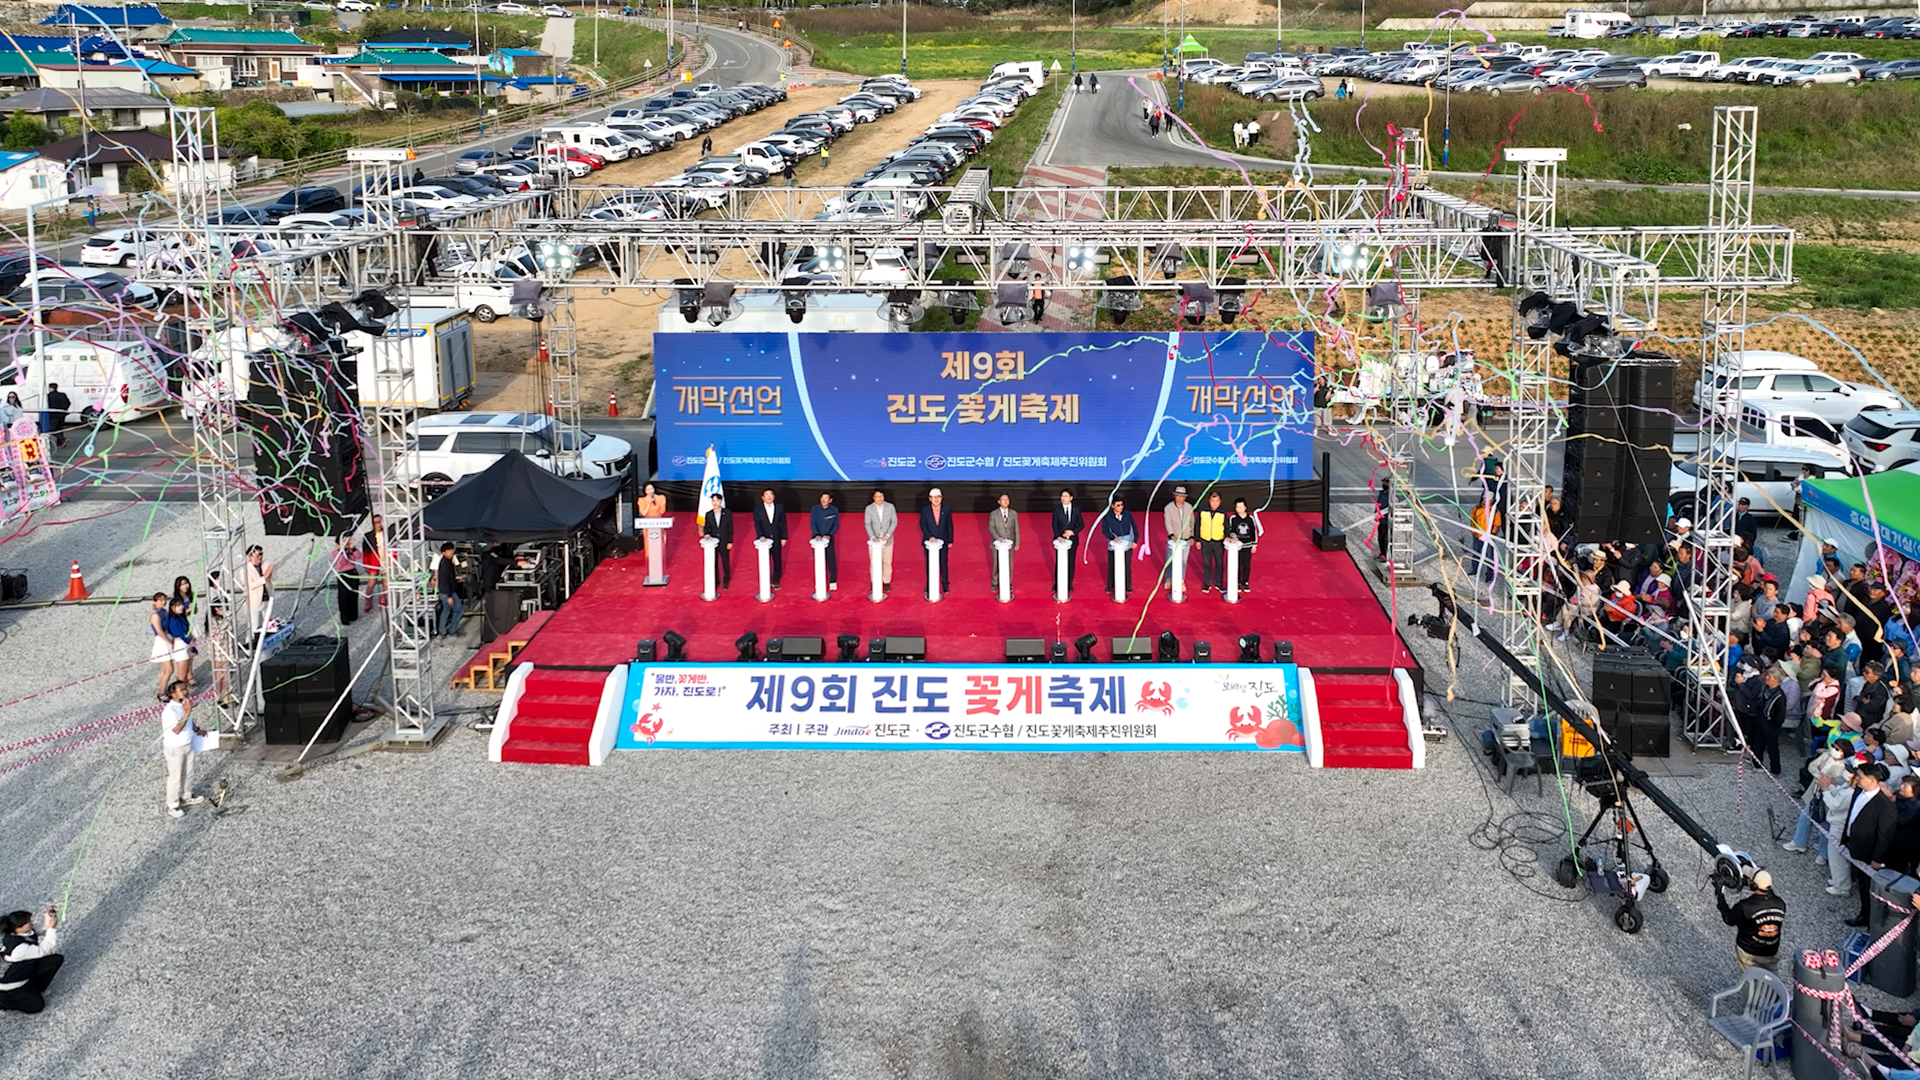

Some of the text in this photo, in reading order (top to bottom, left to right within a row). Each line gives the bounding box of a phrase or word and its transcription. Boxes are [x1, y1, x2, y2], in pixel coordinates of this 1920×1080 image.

[940, 350, 1026, 381] 제9회
[672, 385, 783, 415] 개막선언
[886, 392, 1081, 424] 진도 꽃게축제
[1186, 385, 1295, 415] 개막선언
[887, 456, 917, 468] 진도군
[947, 456, 994, 468] 진도군수협
[1002, 455, 1107, 468] 진도꽃게축제추진위원회
[653, 686, 679, 697] 가자,
[745, 674, 1127, 716] 제9회 진도 꽃게축제
[1248, 680, 1279, 698] 진도
[768, 723, 793, 736] 주최
[804, 723, 829, 737] 주관
[874, 723, 911, 737] 진도군
[953, 724, 1014, 738] 진도군수협
[1024, 724, 1157, 739] 진도꽃게축제추진위원회
